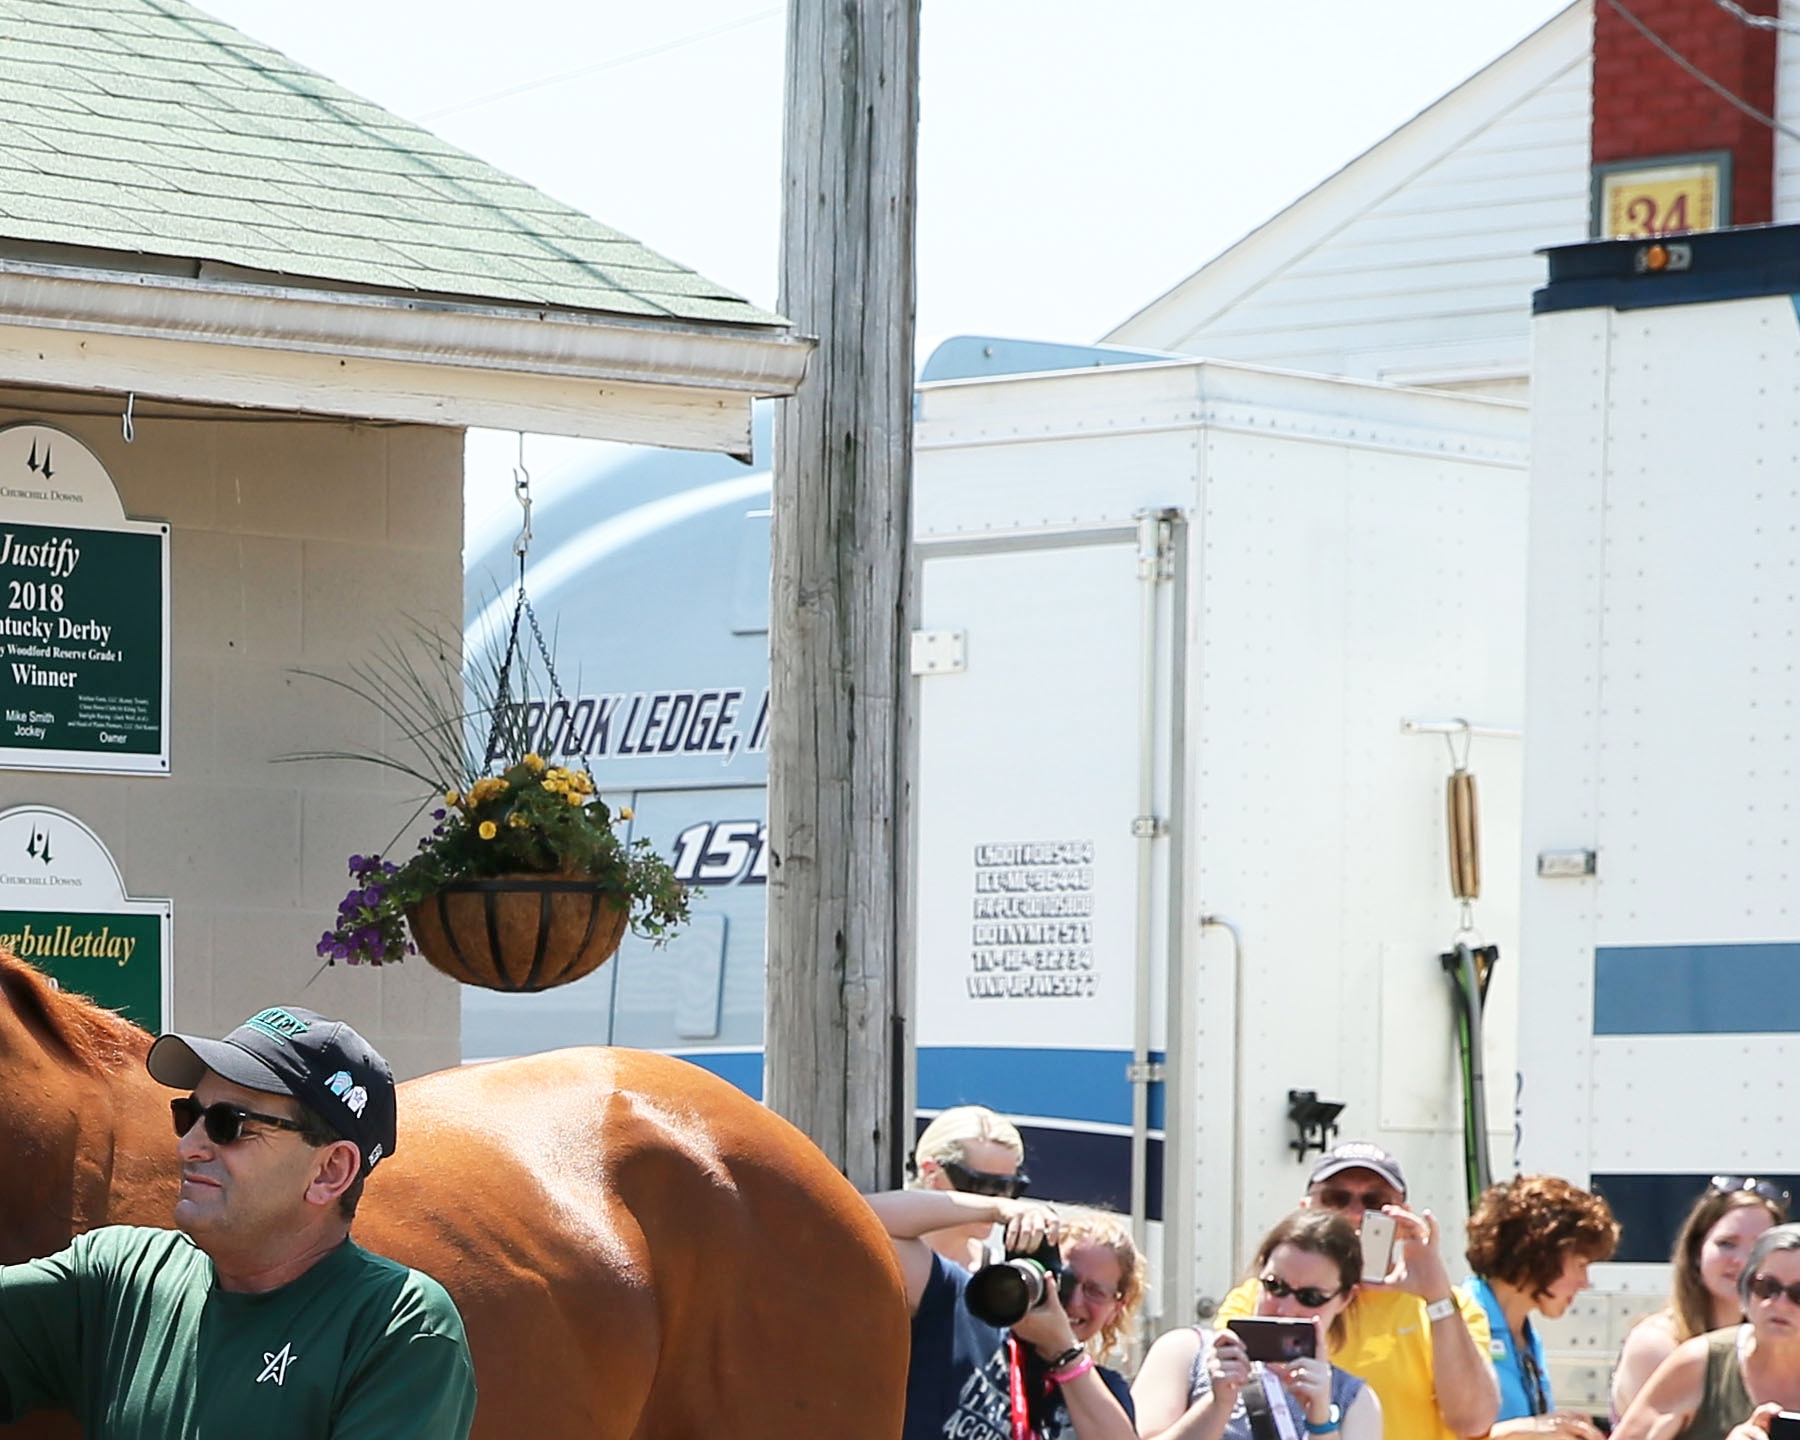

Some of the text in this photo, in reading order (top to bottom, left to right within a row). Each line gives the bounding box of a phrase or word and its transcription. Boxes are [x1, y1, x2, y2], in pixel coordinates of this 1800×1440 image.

[1627, 192, 1692, 239] 34
[8, 581, 64, 612] 2018
[58, 618, 112, 647] Derby
[7, 644, 51, 659] Woodford
[53, 646, 87, 660] Reserve
[88, 648, 115, 662] Grade
[11, 664, 78, 689] Winner
[6, 709, 55, 724] Mike Smith
[616, 690, 745, 765] LEDGE,
[14, 724, 46, 740] Jockey
[99, 731, 127, 744] Owner
